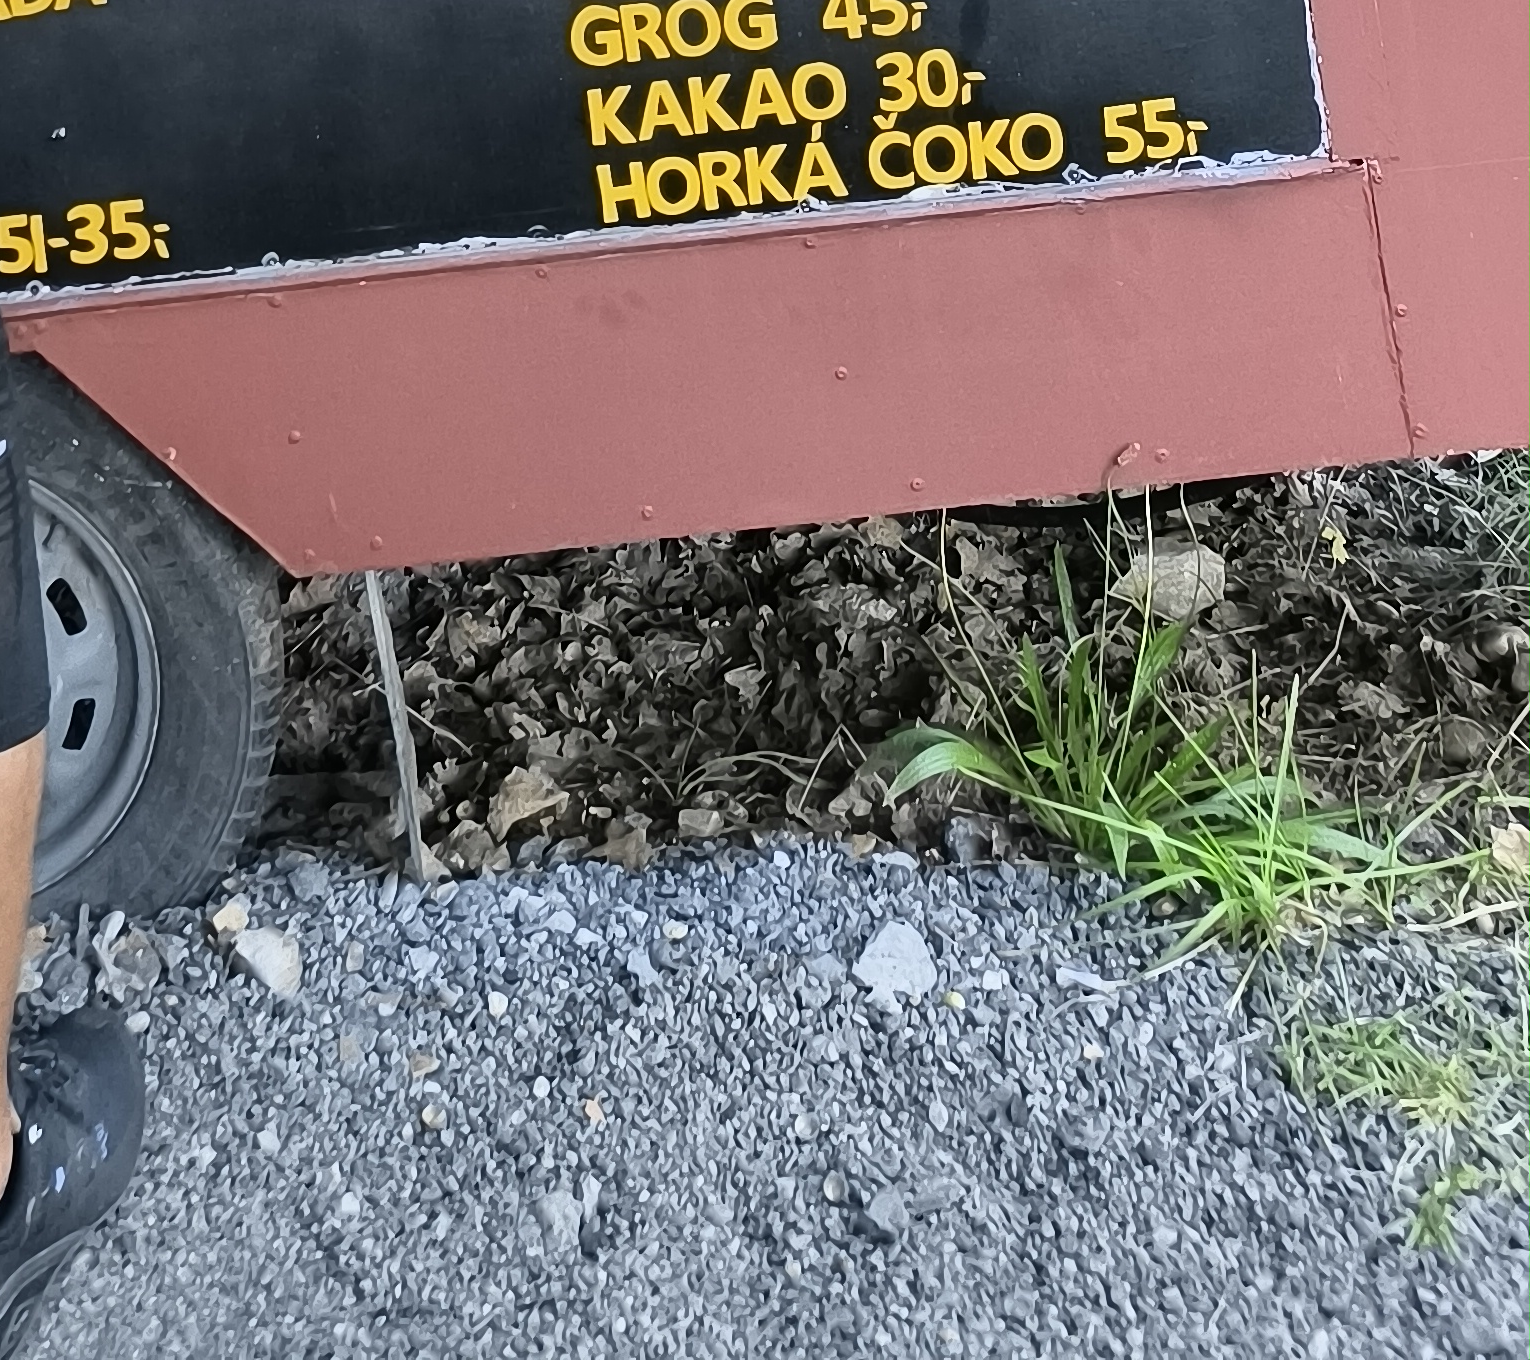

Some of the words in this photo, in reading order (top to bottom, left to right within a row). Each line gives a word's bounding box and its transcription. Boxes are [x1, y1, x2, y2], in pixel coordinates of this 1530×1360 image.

[586, 61, 847, 147] KAKAO
[595, 122, 848, 225] HORKÁ
[868, 112, 1064, 191] ČOKO
